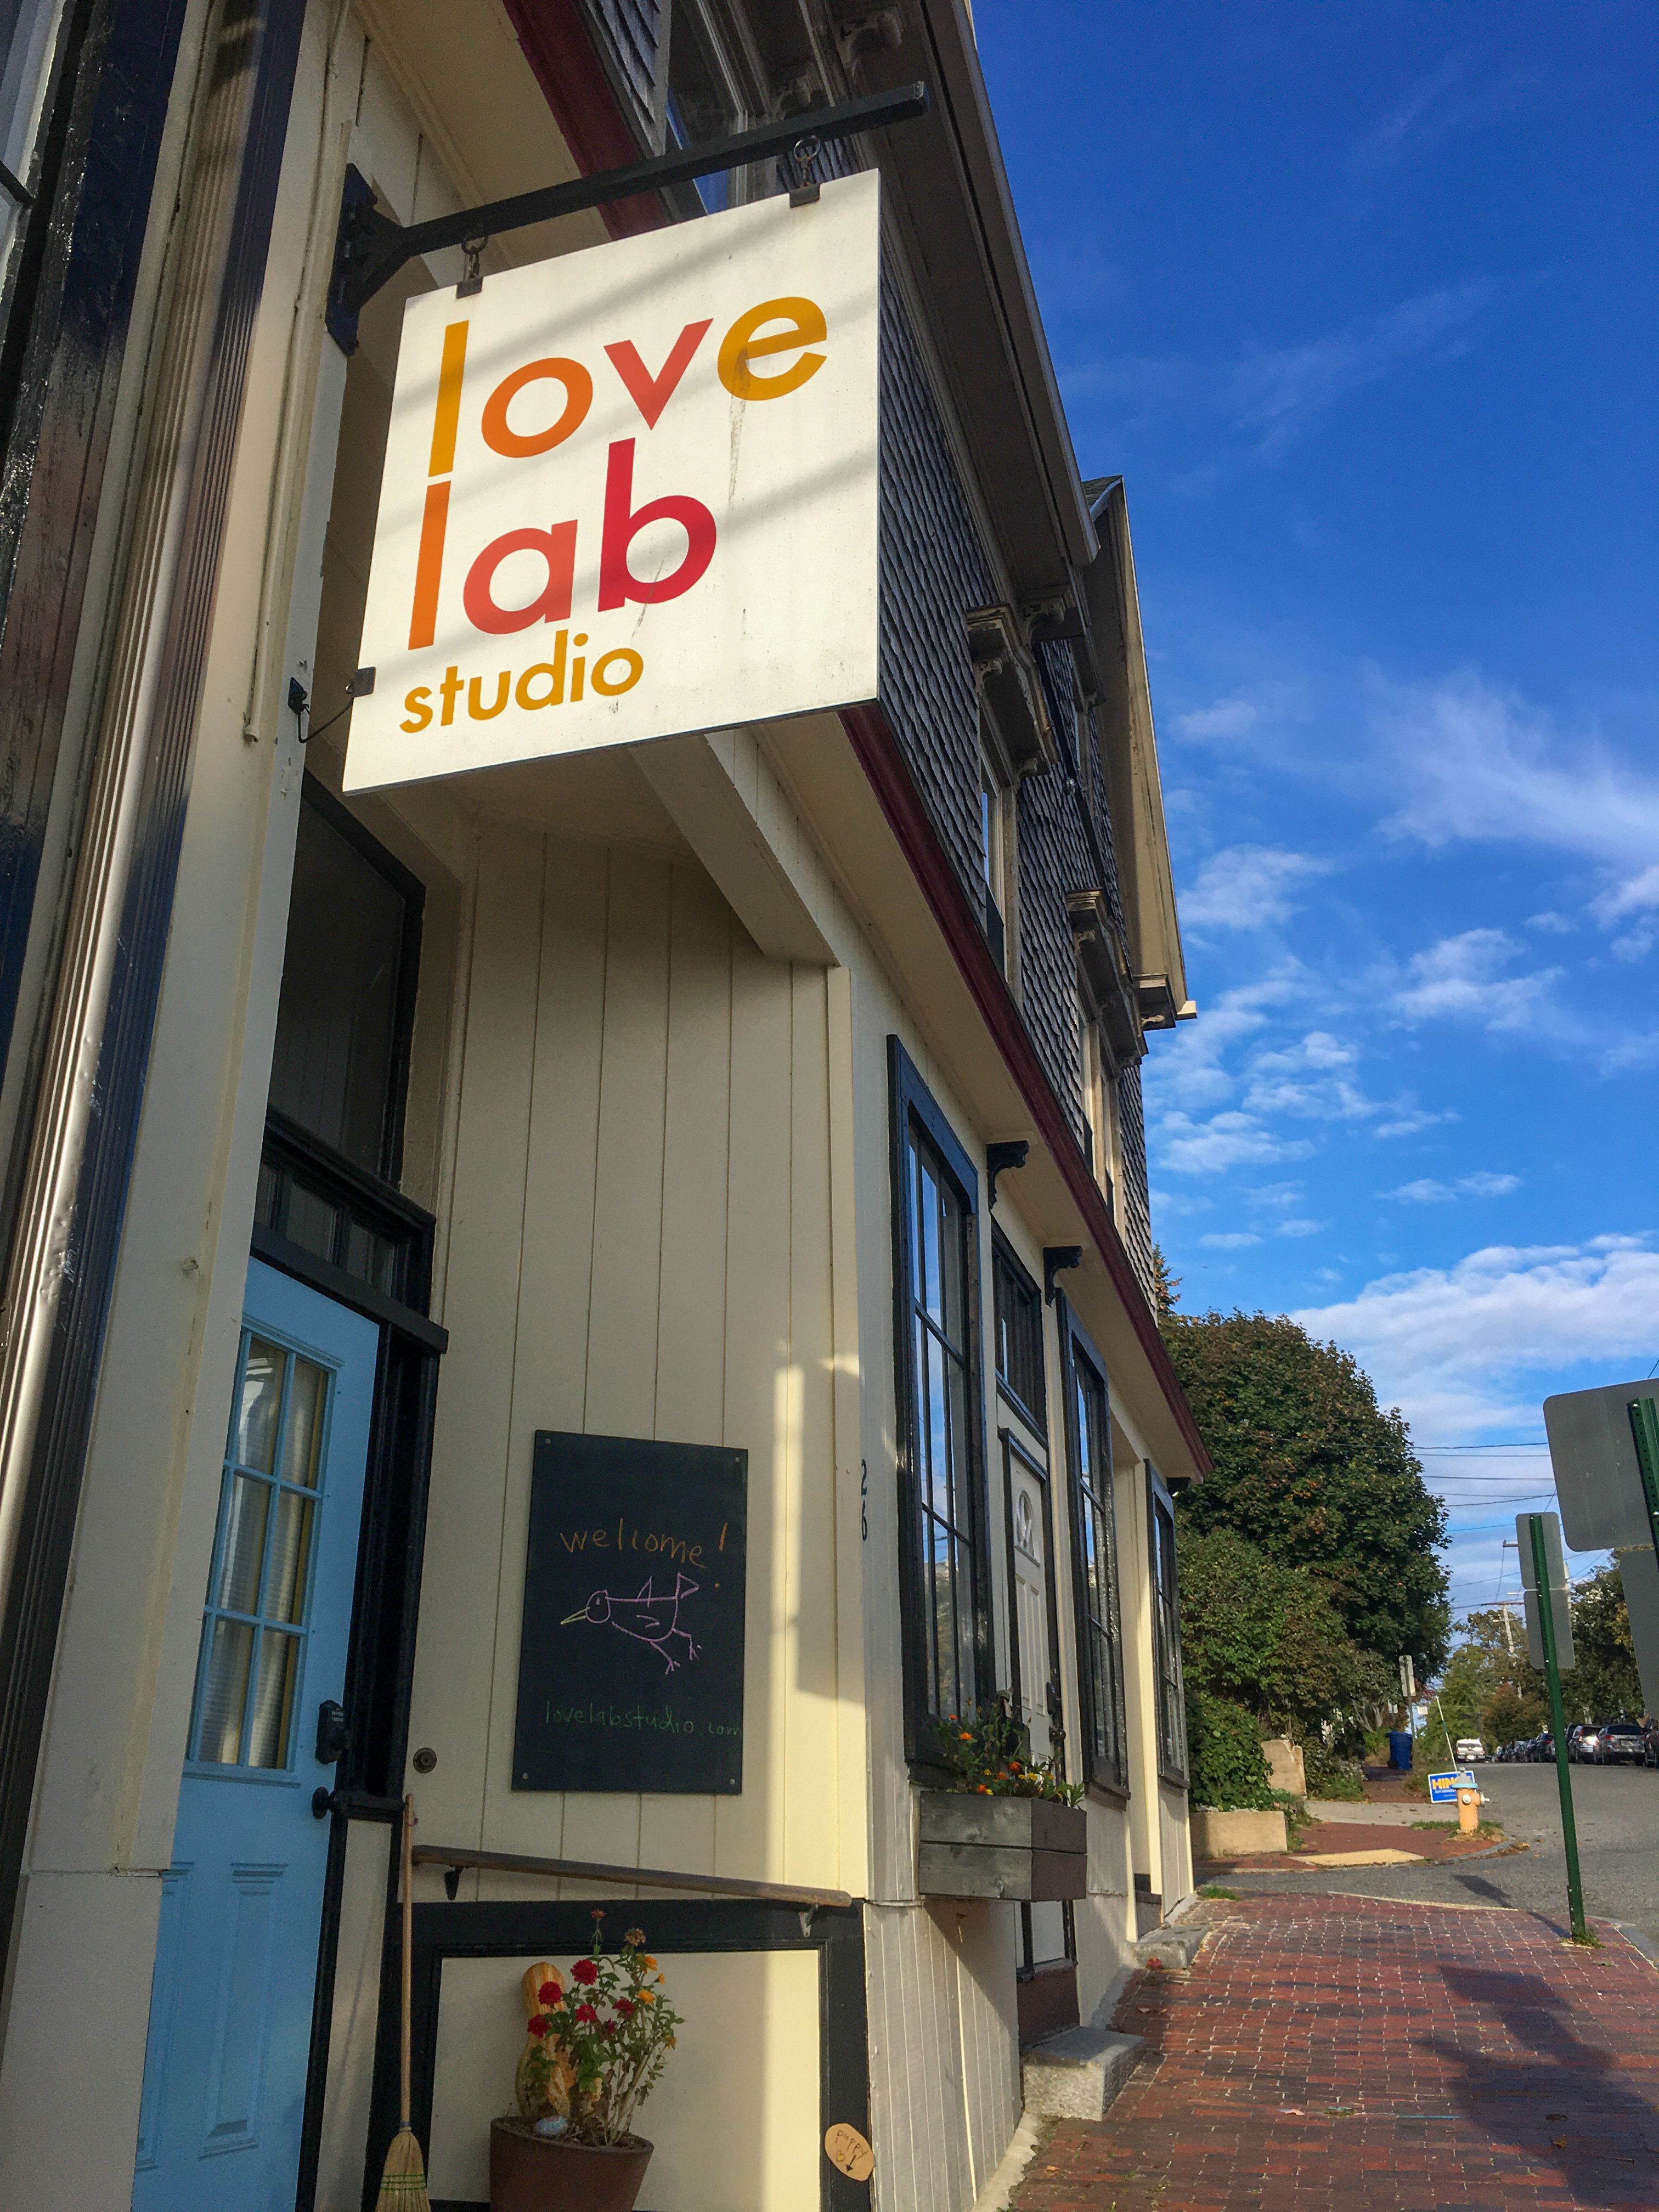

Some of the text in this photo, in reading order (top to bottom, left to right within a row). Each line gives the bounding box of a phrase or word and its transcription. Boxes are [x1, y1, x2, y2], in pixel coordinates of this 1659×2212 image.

[428, 296, 827, 478] love
[408, 437, 717, 651] lab
[399, 629, 644, 734] studio
[861, 1458, 868, 1542] 26
